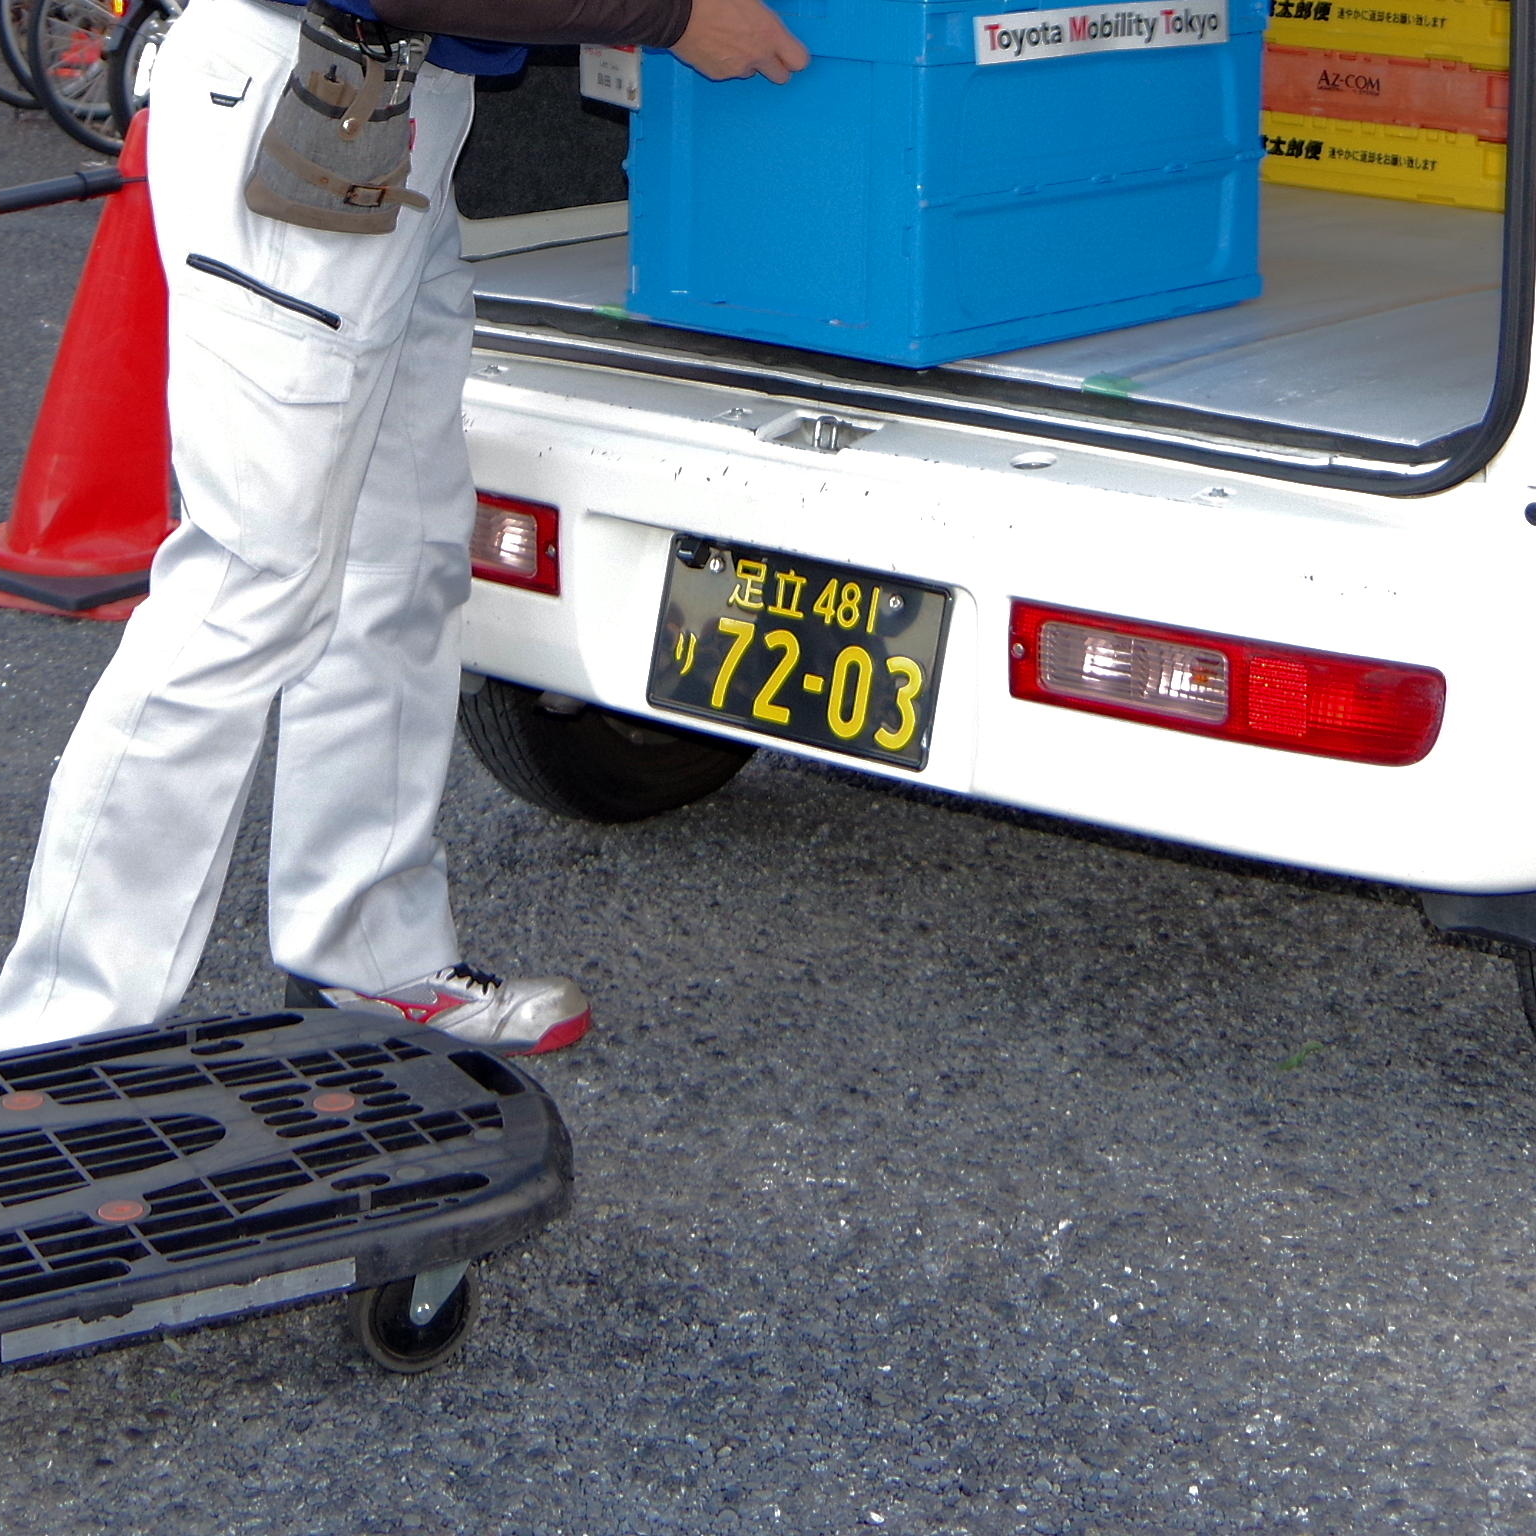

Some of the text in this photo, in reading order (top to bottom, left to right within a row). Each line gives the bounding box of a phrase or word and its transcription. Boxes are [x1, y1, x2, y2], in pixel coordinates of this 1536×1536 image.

[984, 9, 1219, 56] Toyota Mobility Tokyo
[1317, 69, 1381, 91] AZ-COM
[727, 559, 881, 634] 足立 481
[711, 616, 923, 751] 72-03
